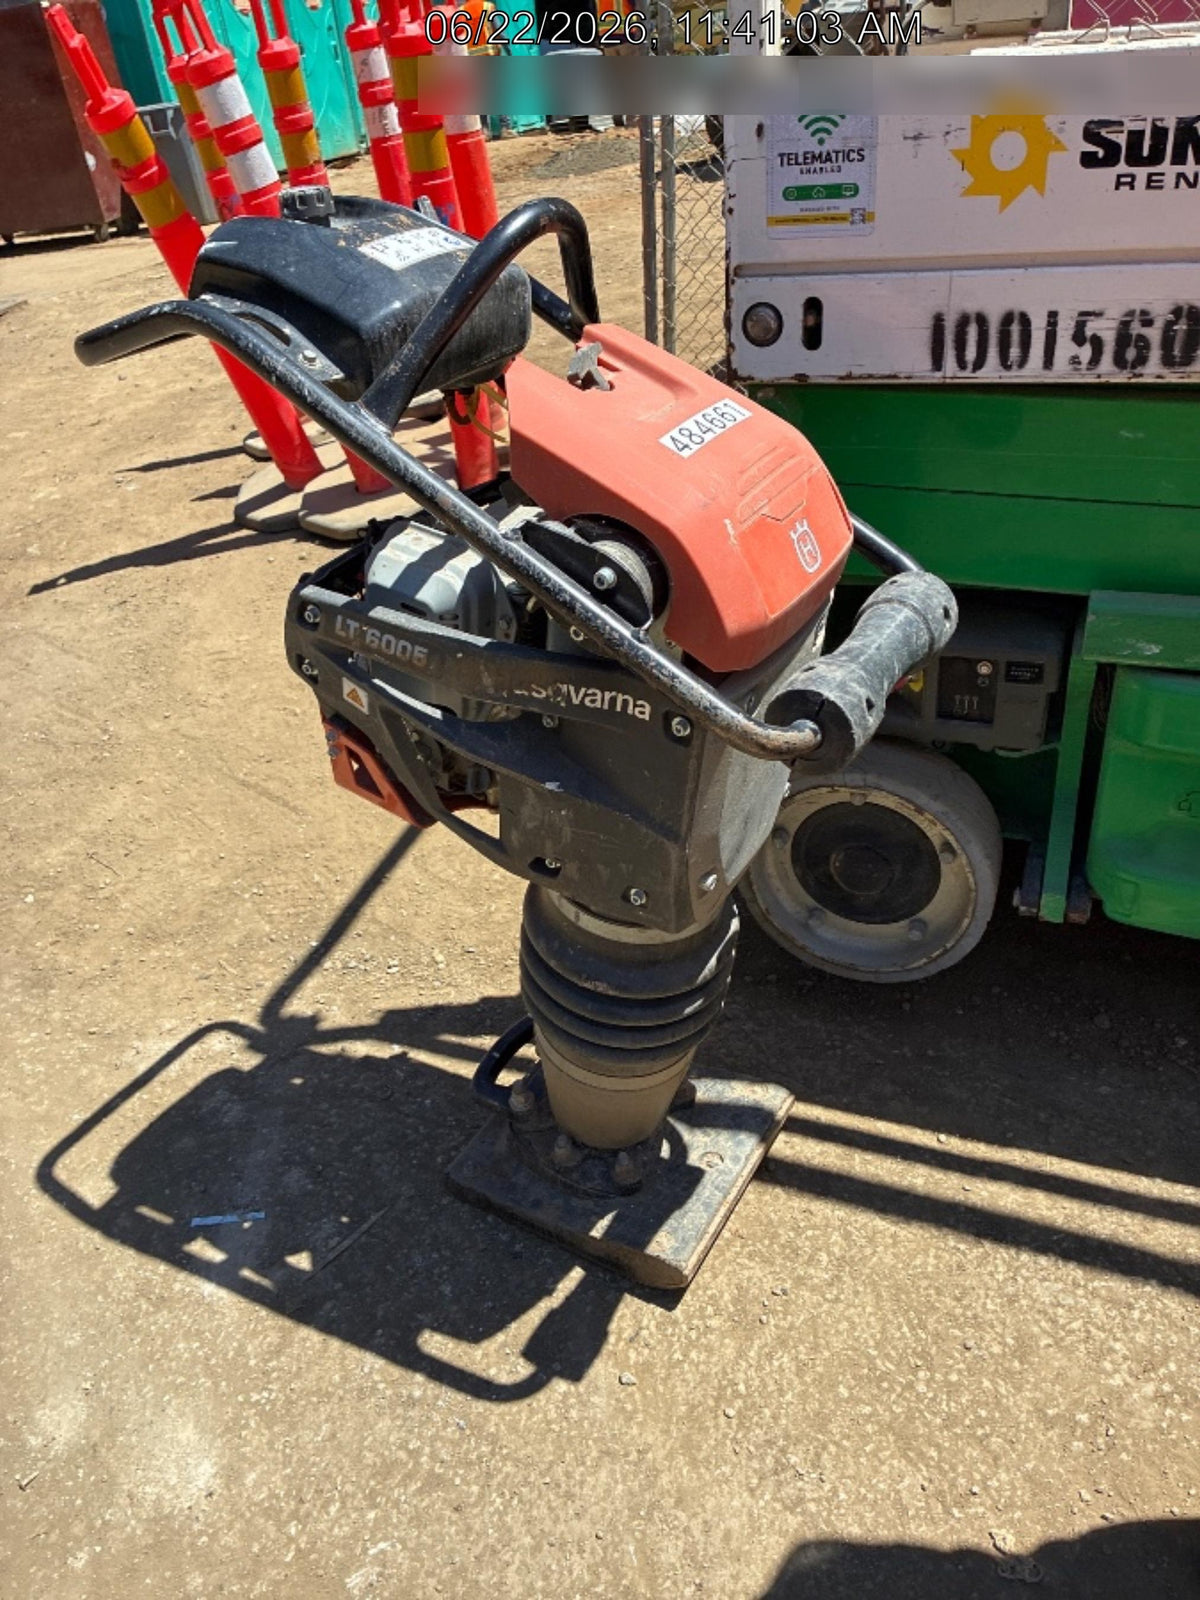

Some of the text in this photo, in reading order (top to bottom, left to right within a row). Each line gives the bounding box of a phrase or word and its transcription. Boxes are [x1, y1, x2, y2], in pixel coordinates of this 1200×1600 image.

[777, 148, 866, 168] TELEMATICS
[1114, 171, 1200, 191] REN
[930, 304, 1200, 374] 1001560
[669, 402, 746, 453] 484661
[334, 614, 429, 667] LT 6005
